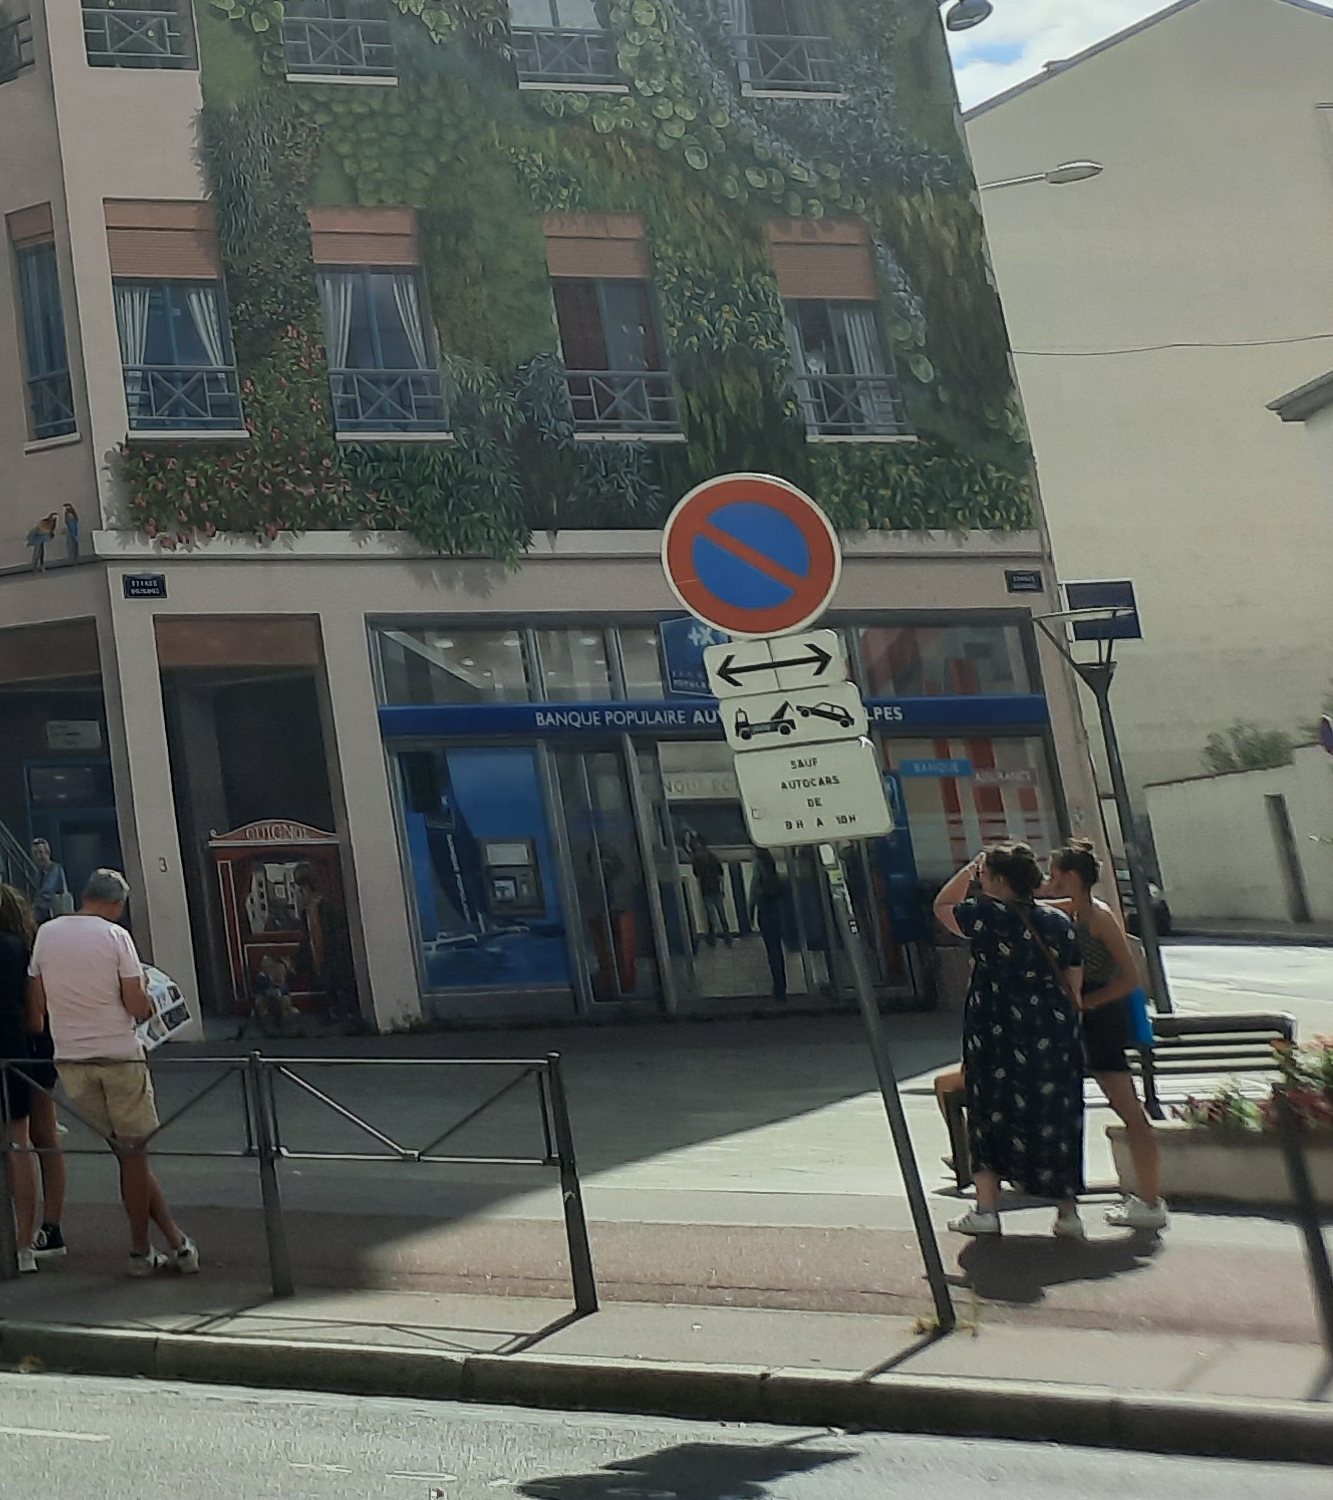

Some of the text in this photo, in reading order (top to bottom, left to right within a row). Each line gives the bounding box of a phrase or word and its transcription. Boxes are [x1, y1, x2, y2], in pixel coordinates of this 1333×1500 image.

[535, 710, 602, 728] BANQUE
[604, 710, 687, 726] POPULAIRE
[790, 757, 818, 770] SAUF
[781, 775, 841, 790] AUTOCARS
[807, 797, 822, 807] DE
[816, 817, 824, 827] A
[158, 857, 168, 873] 3
